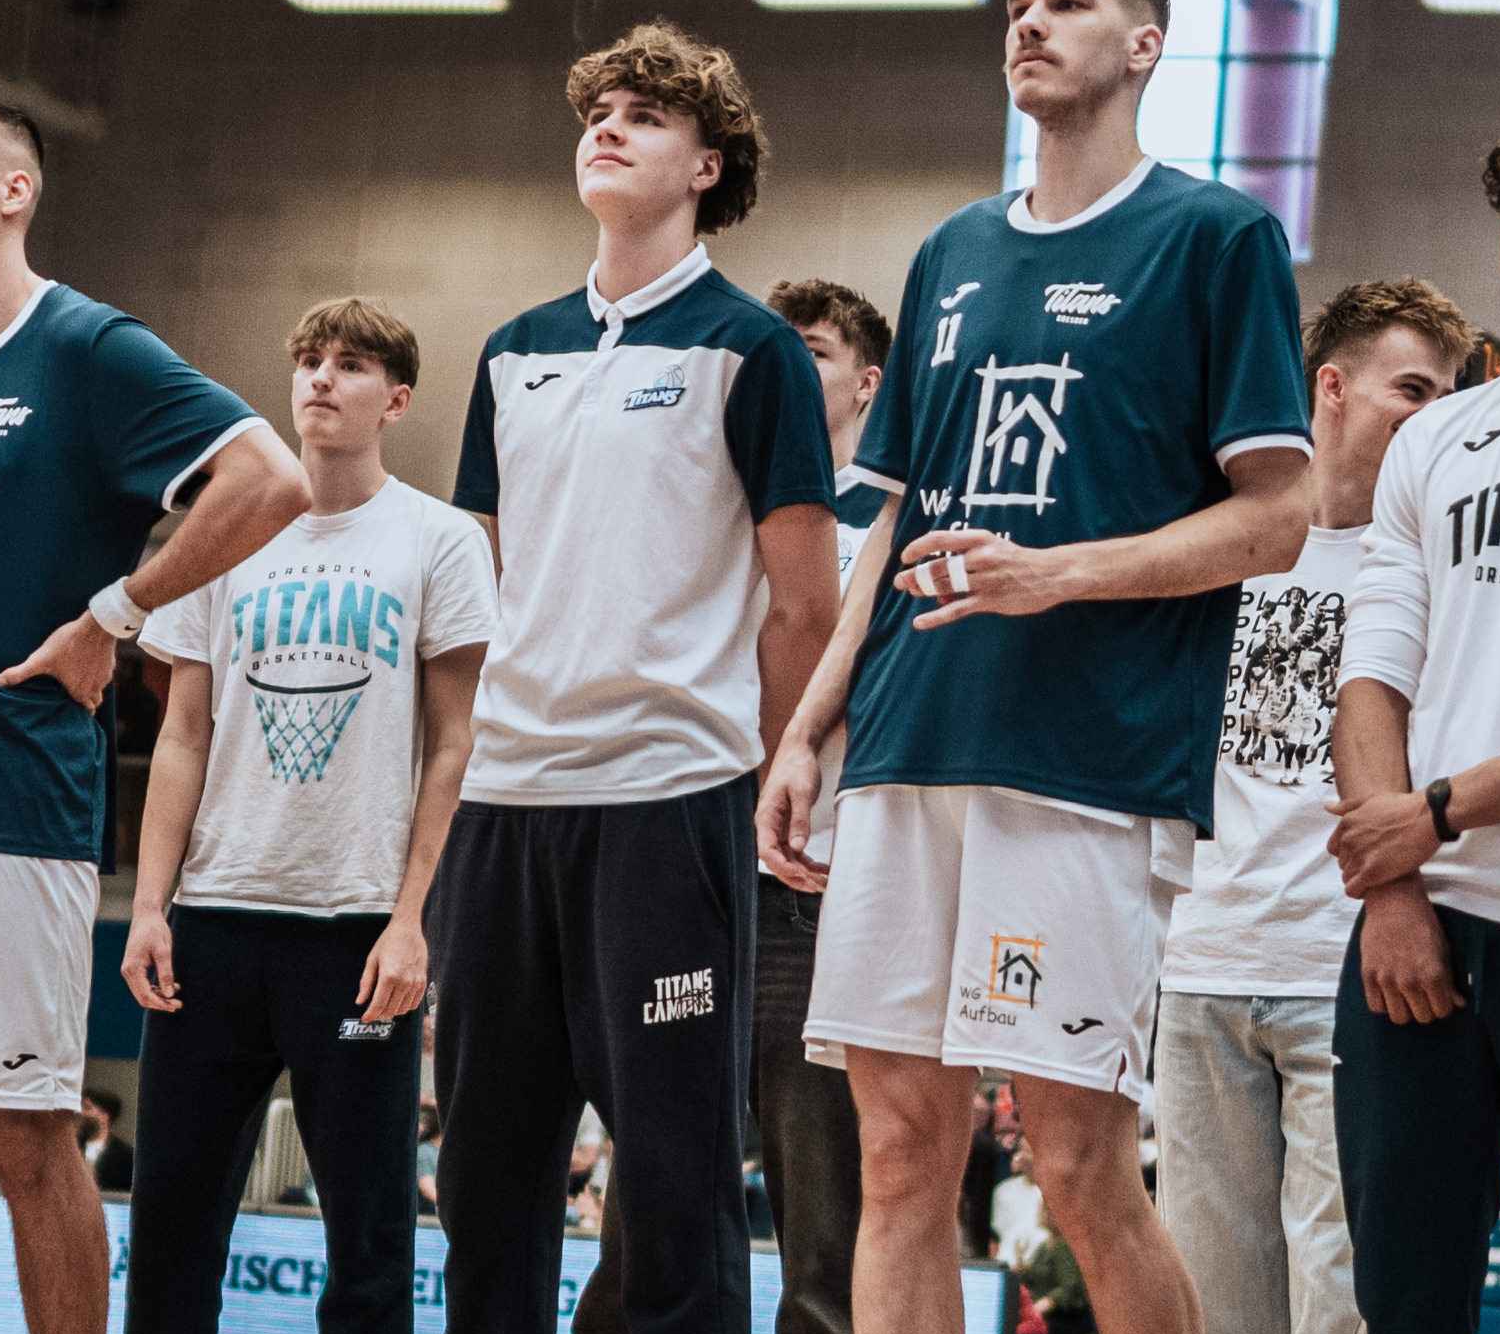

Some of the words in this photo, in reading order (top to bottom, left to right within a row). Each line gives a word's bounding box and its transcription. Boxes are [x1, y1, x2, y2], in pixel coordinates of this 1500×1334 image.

[1044, 282, 1122, 315] Titans
[231, 579, 405, 669] TITANS
[251, 650, 369, 672] BASKETBALL
[653, 967, 713, 1000] TITANS
[960, 985, 982, 1001] WG
[960, 1003, 1017, 1027] Aufbau
